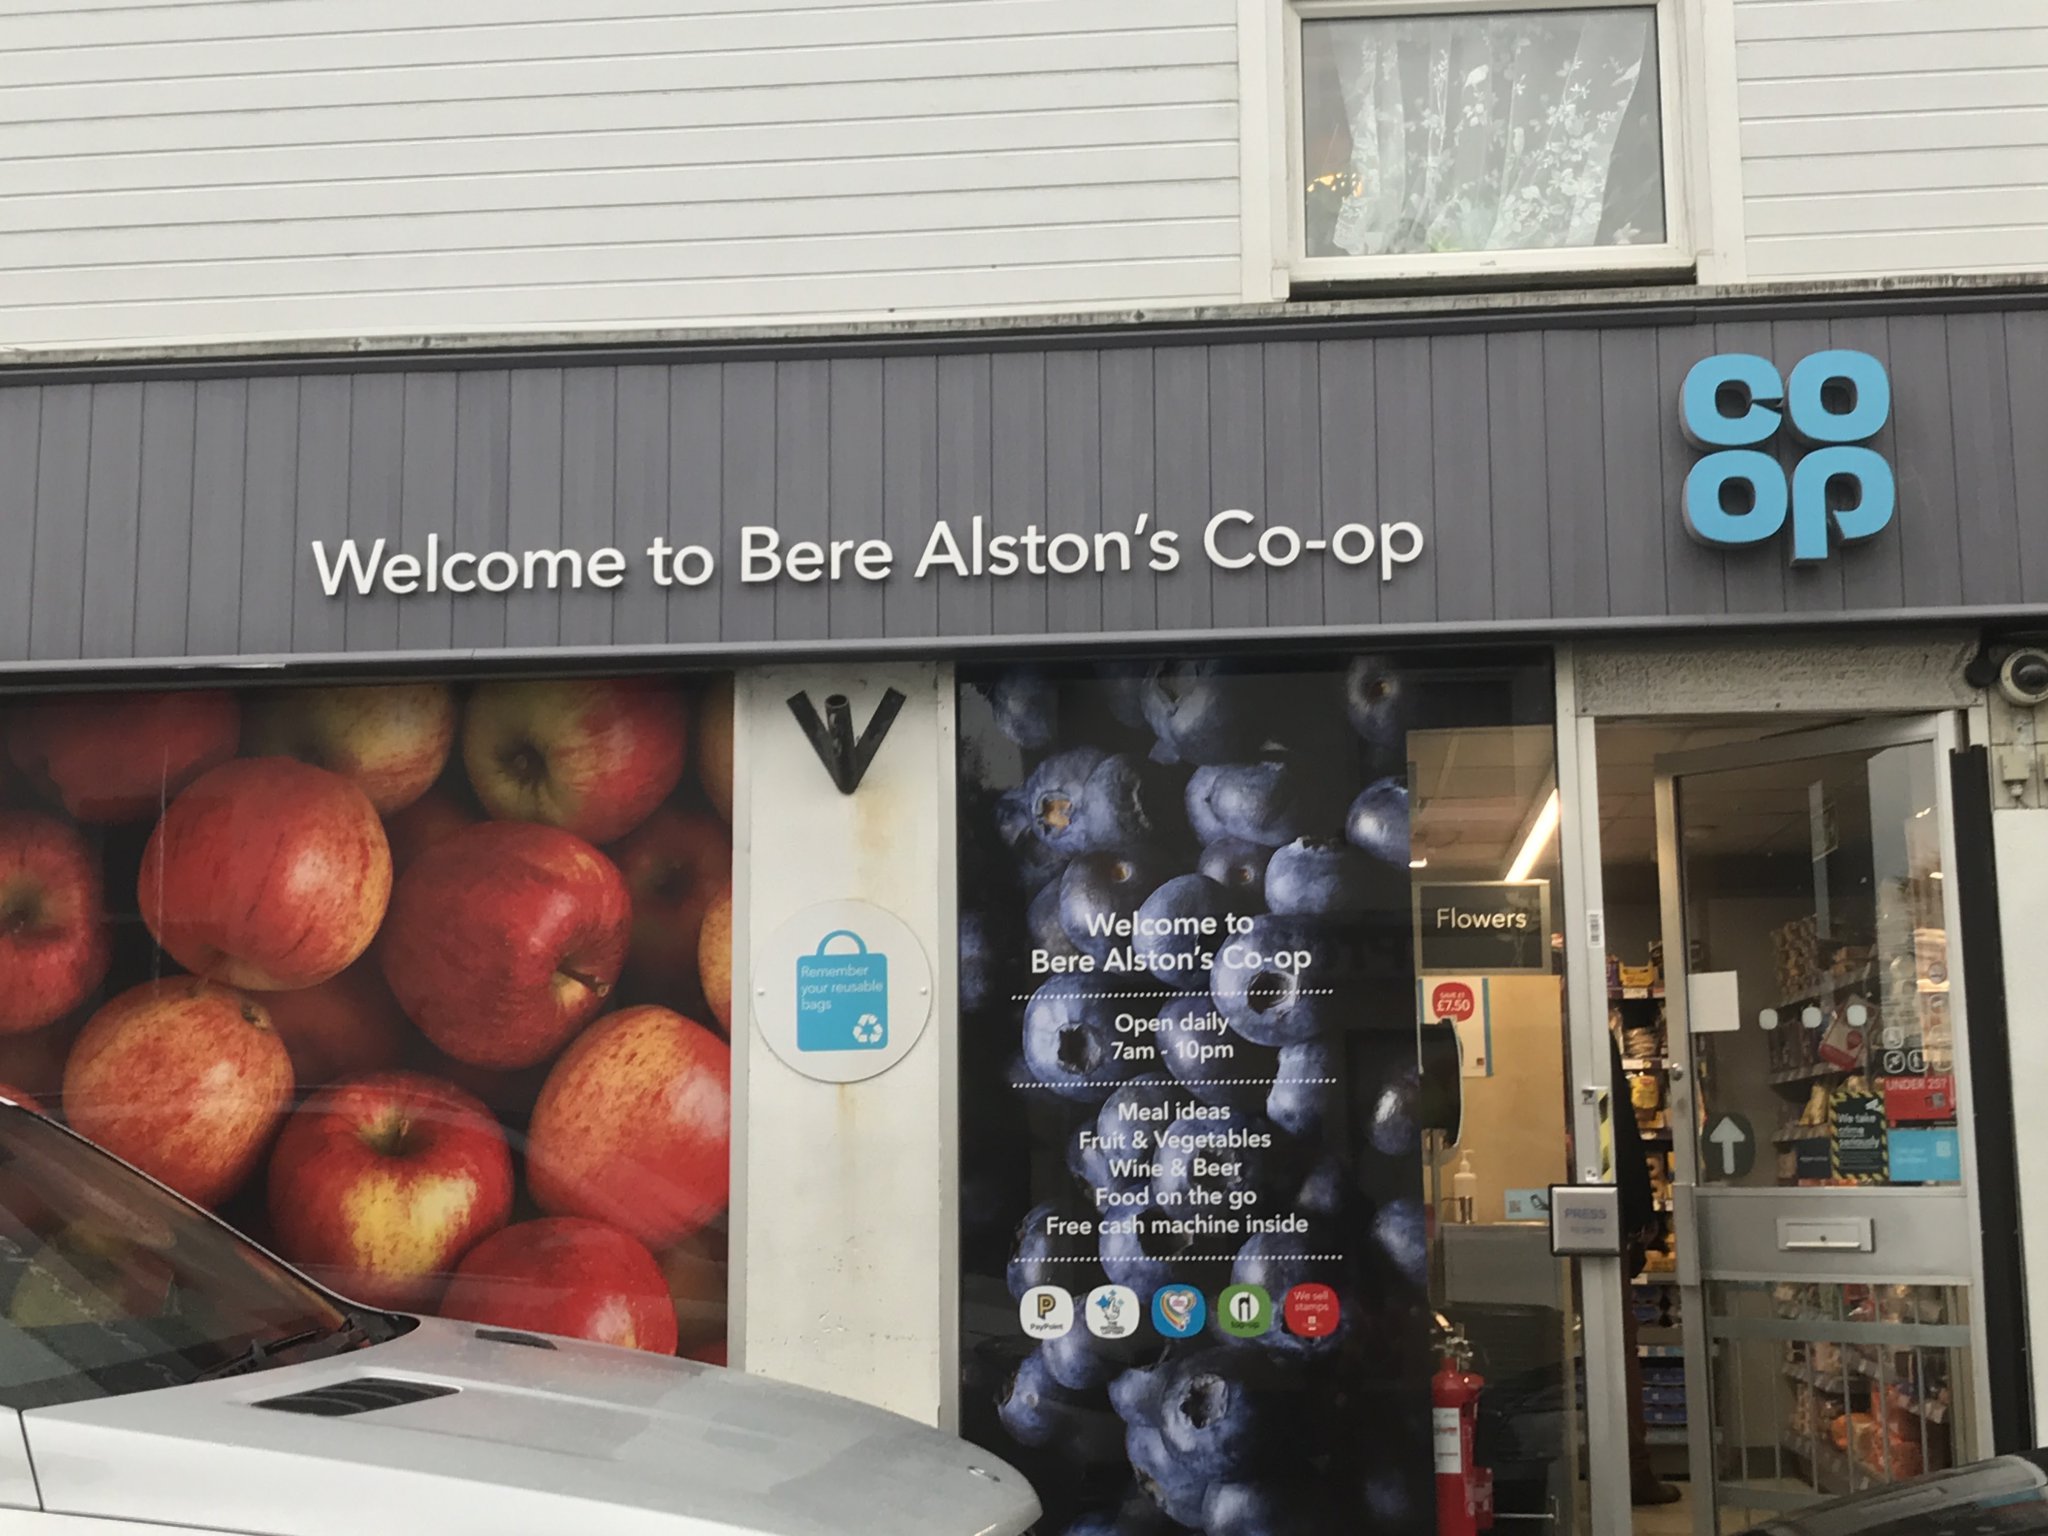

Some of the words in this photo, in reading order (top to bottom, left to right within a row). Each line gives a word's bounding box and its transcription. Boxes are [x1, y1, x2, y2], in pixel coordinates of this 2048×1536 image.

[312, 533, 626, 595] Welcome
[646, 536, 715, 586] to
[740, 526, 894, 582] Bere
[914, 513, 1180, 578] Alston's
[1204, 509, 1424, 581] Co-op
[1085, 911, 1217, 937] Welcome
[1225, 912, 1254, 935] to
[1437, 907, 1527, 929] Flowers
[1031, 949, 1095, 973] Bere
[1103, 946, 1214, 972] Alston's
[1223, 946, 1312, 974] Co-op
[801, 963, 869, 978] Remember
[801, 984, 828, 997] your
[832, 979, 883, 993] reusable
[801, 999, 832, 1013] bags
[1436, 999, 1471, 1012] £7.50
[1115, 1013, 1173, 1037] Open
[1180, 1012, 1229, 1036] daily
[1111, 1041, 1155, 1060] 7am
[1176, 1040, 1234, 1063] 10pm
[1886, 1078, 1925, 1091] UNDER
[1118, 1102, 1169, 1121] Meal
[1176, 1101, 1231, 1121] ideas
[1079, 1131, 1126, 1150] Fruit
[1132, 1131, 1148, 1149] &
[1153, 1128, 1272, 1153] Vegetables
[1109, 1158, 1164, 1177] Wine
[1170, 1158, 1187, 1177] &
[1193, 1158, 1243, 1177] Beer
[1095, 1186, 1149, 1206] Food
[1155, 1190, 1183, 1205] on
[1188, 1185, 1222, 1205] the
[1229, 1189, 1257, 1210] go
[1046, 1216, 1092, 1235] Free
[1098, 1214, 1144, 1234] cash
[1151, 1213, 1240, 1234] machine
[1246, 1212, 1309, 1233] inside
[1564, 1208, 1607, 1220] PRESS
[1294, 1291, 1310, 1301] We
[1313, 1290, 1329, 1301] sell
[1295, 1302, 1329, 1313] stamps
[1030, 1322, 1063, 1331] PayPoint
